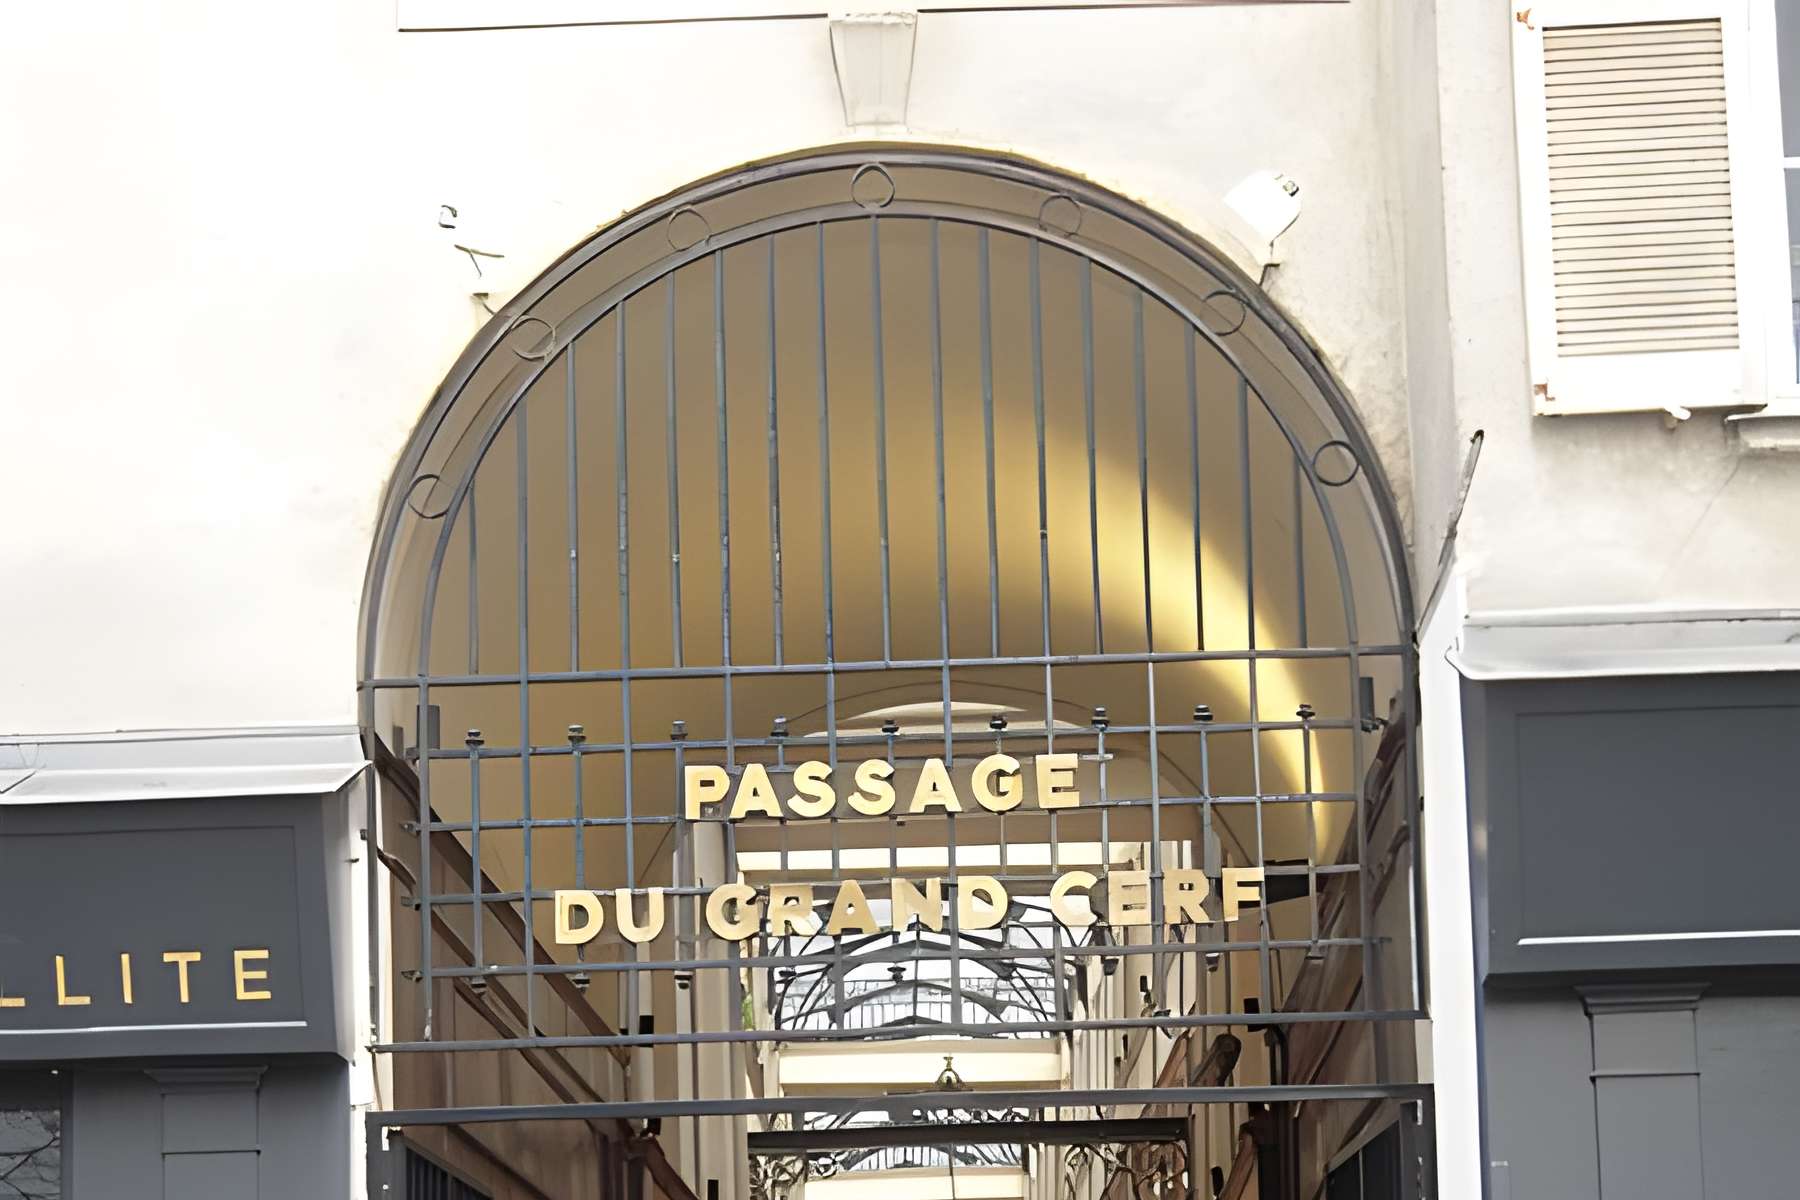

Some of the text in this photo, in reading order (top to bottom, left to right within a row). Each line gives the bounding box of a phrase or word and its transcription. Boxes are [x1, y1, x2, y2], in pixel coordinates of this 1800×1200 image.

[684, 753, 1081, 822] PASSAGE
[554, 867, 1265, 945] DU GRAND CERF
